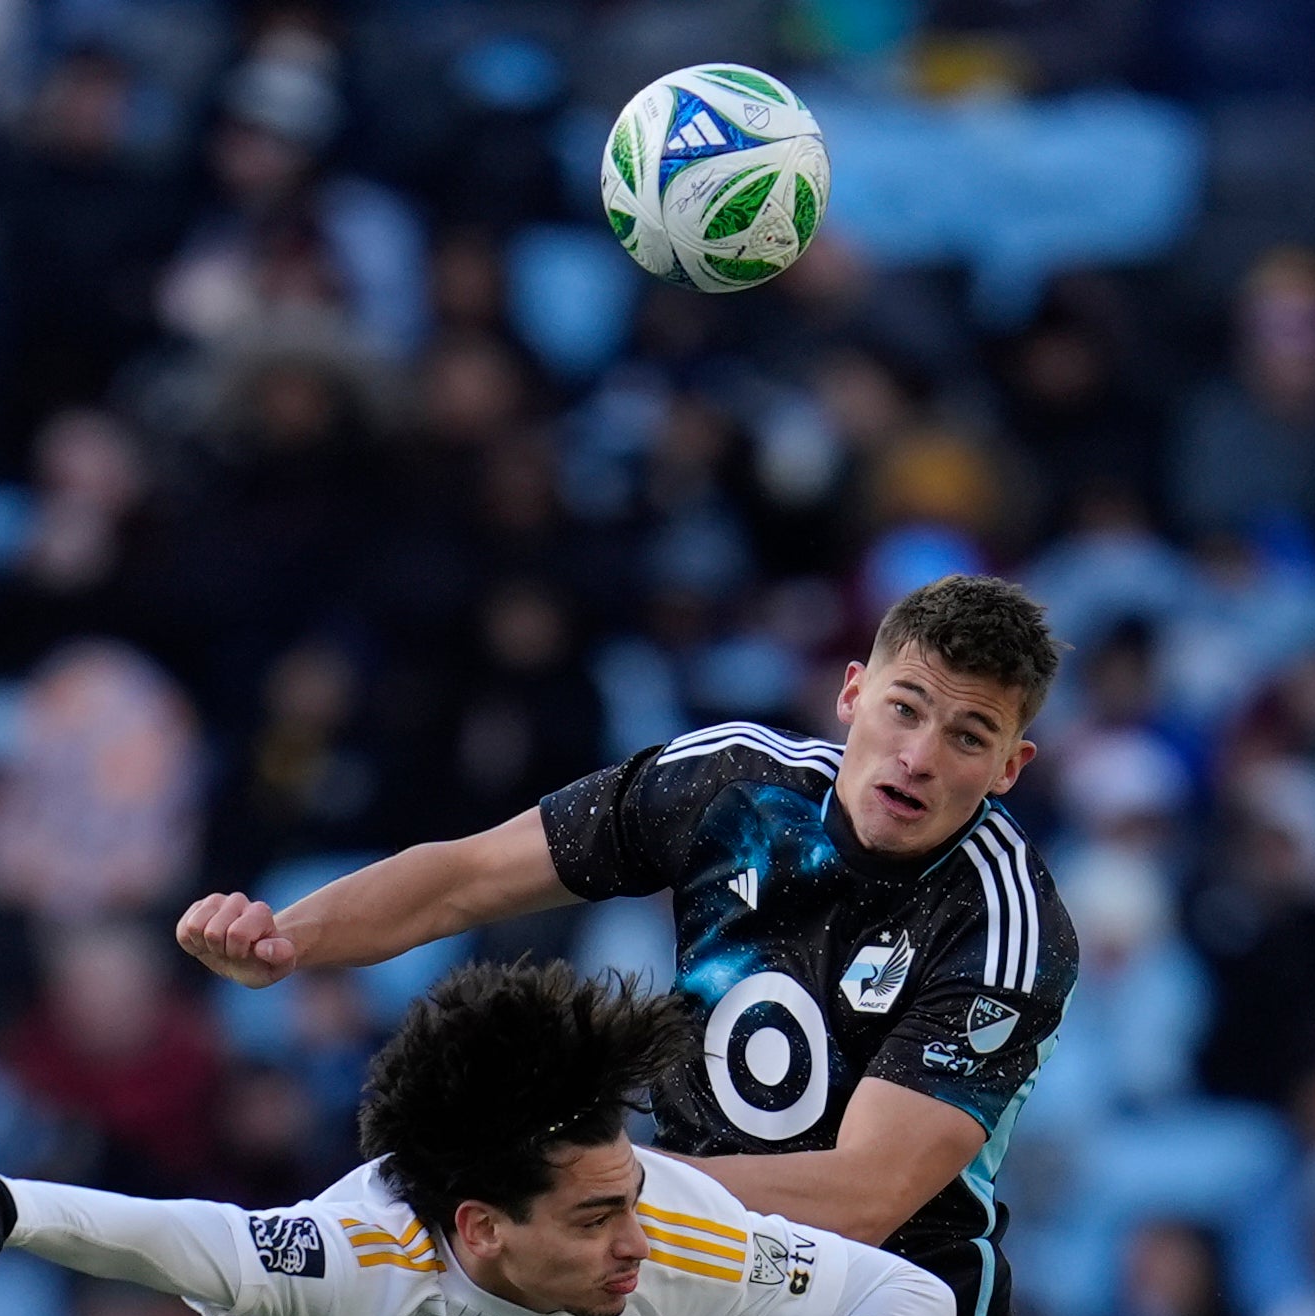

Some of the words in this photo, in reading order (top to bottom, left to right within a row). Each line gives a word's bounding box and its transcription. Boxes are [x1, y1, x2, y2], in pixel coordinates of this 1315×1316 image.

[976, 998, 1003, 1019] MLS
[790, 1232, 816, 1266] tv
[753, 1253, 763, 1280] MLS
